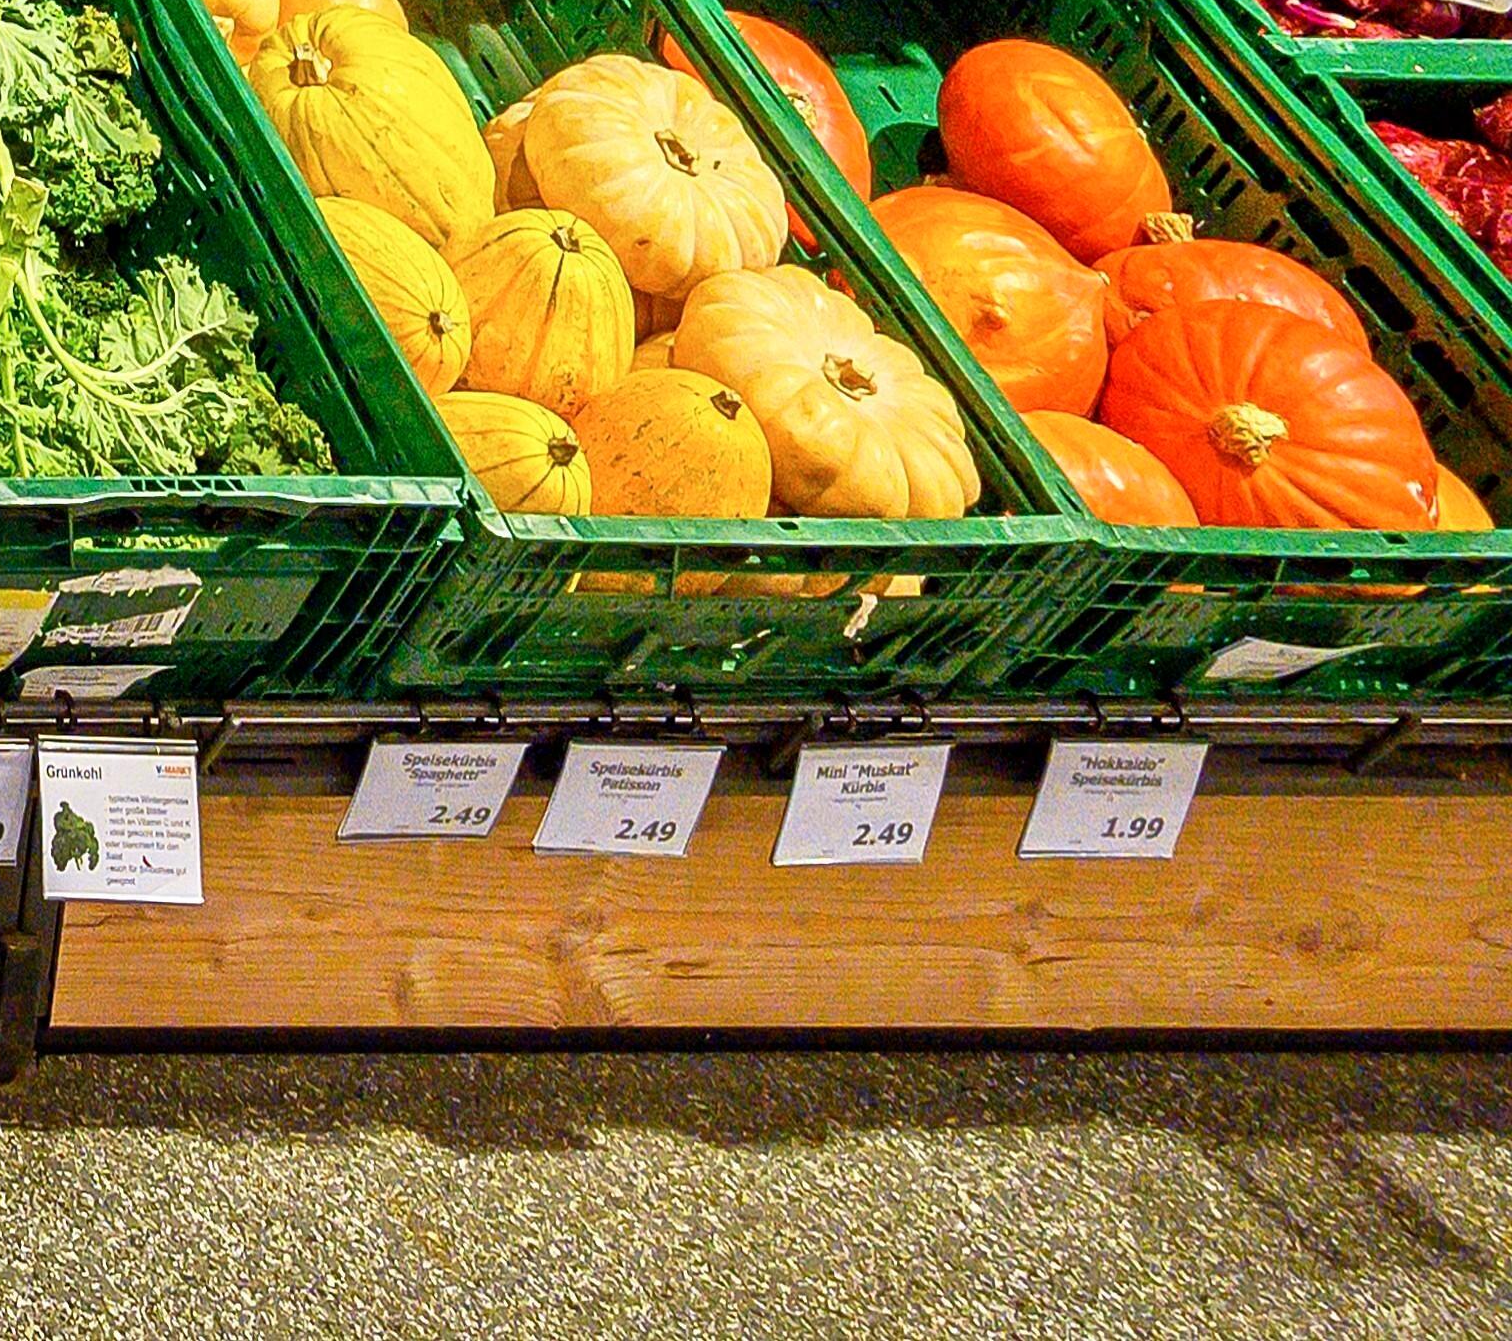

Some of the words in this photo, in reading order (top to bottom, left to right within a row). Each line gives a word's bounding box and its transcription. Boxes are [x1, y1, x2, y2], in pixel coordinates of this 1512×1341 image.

[46, 764, 102, 780] Grünkohl
[156, 765, 192, 775] V-MARKT
[401, 752, 498, 773] Speisekürbis
[589, 760, 684, 783] Speisekürbis
[816, 764, 849, 780] Mini
[600, 776, 662, 792] Patisson
[840, 779, 886, 795] Kürbis
[1069, 771, 1163, 788] Speisekürbis
[427, 805, 492, 826] 2.49
[614, 818, 677, 843] 2.49
[852, 822, 914, 846] 2.49
[1100, 816, 1165, 840] 1.99
